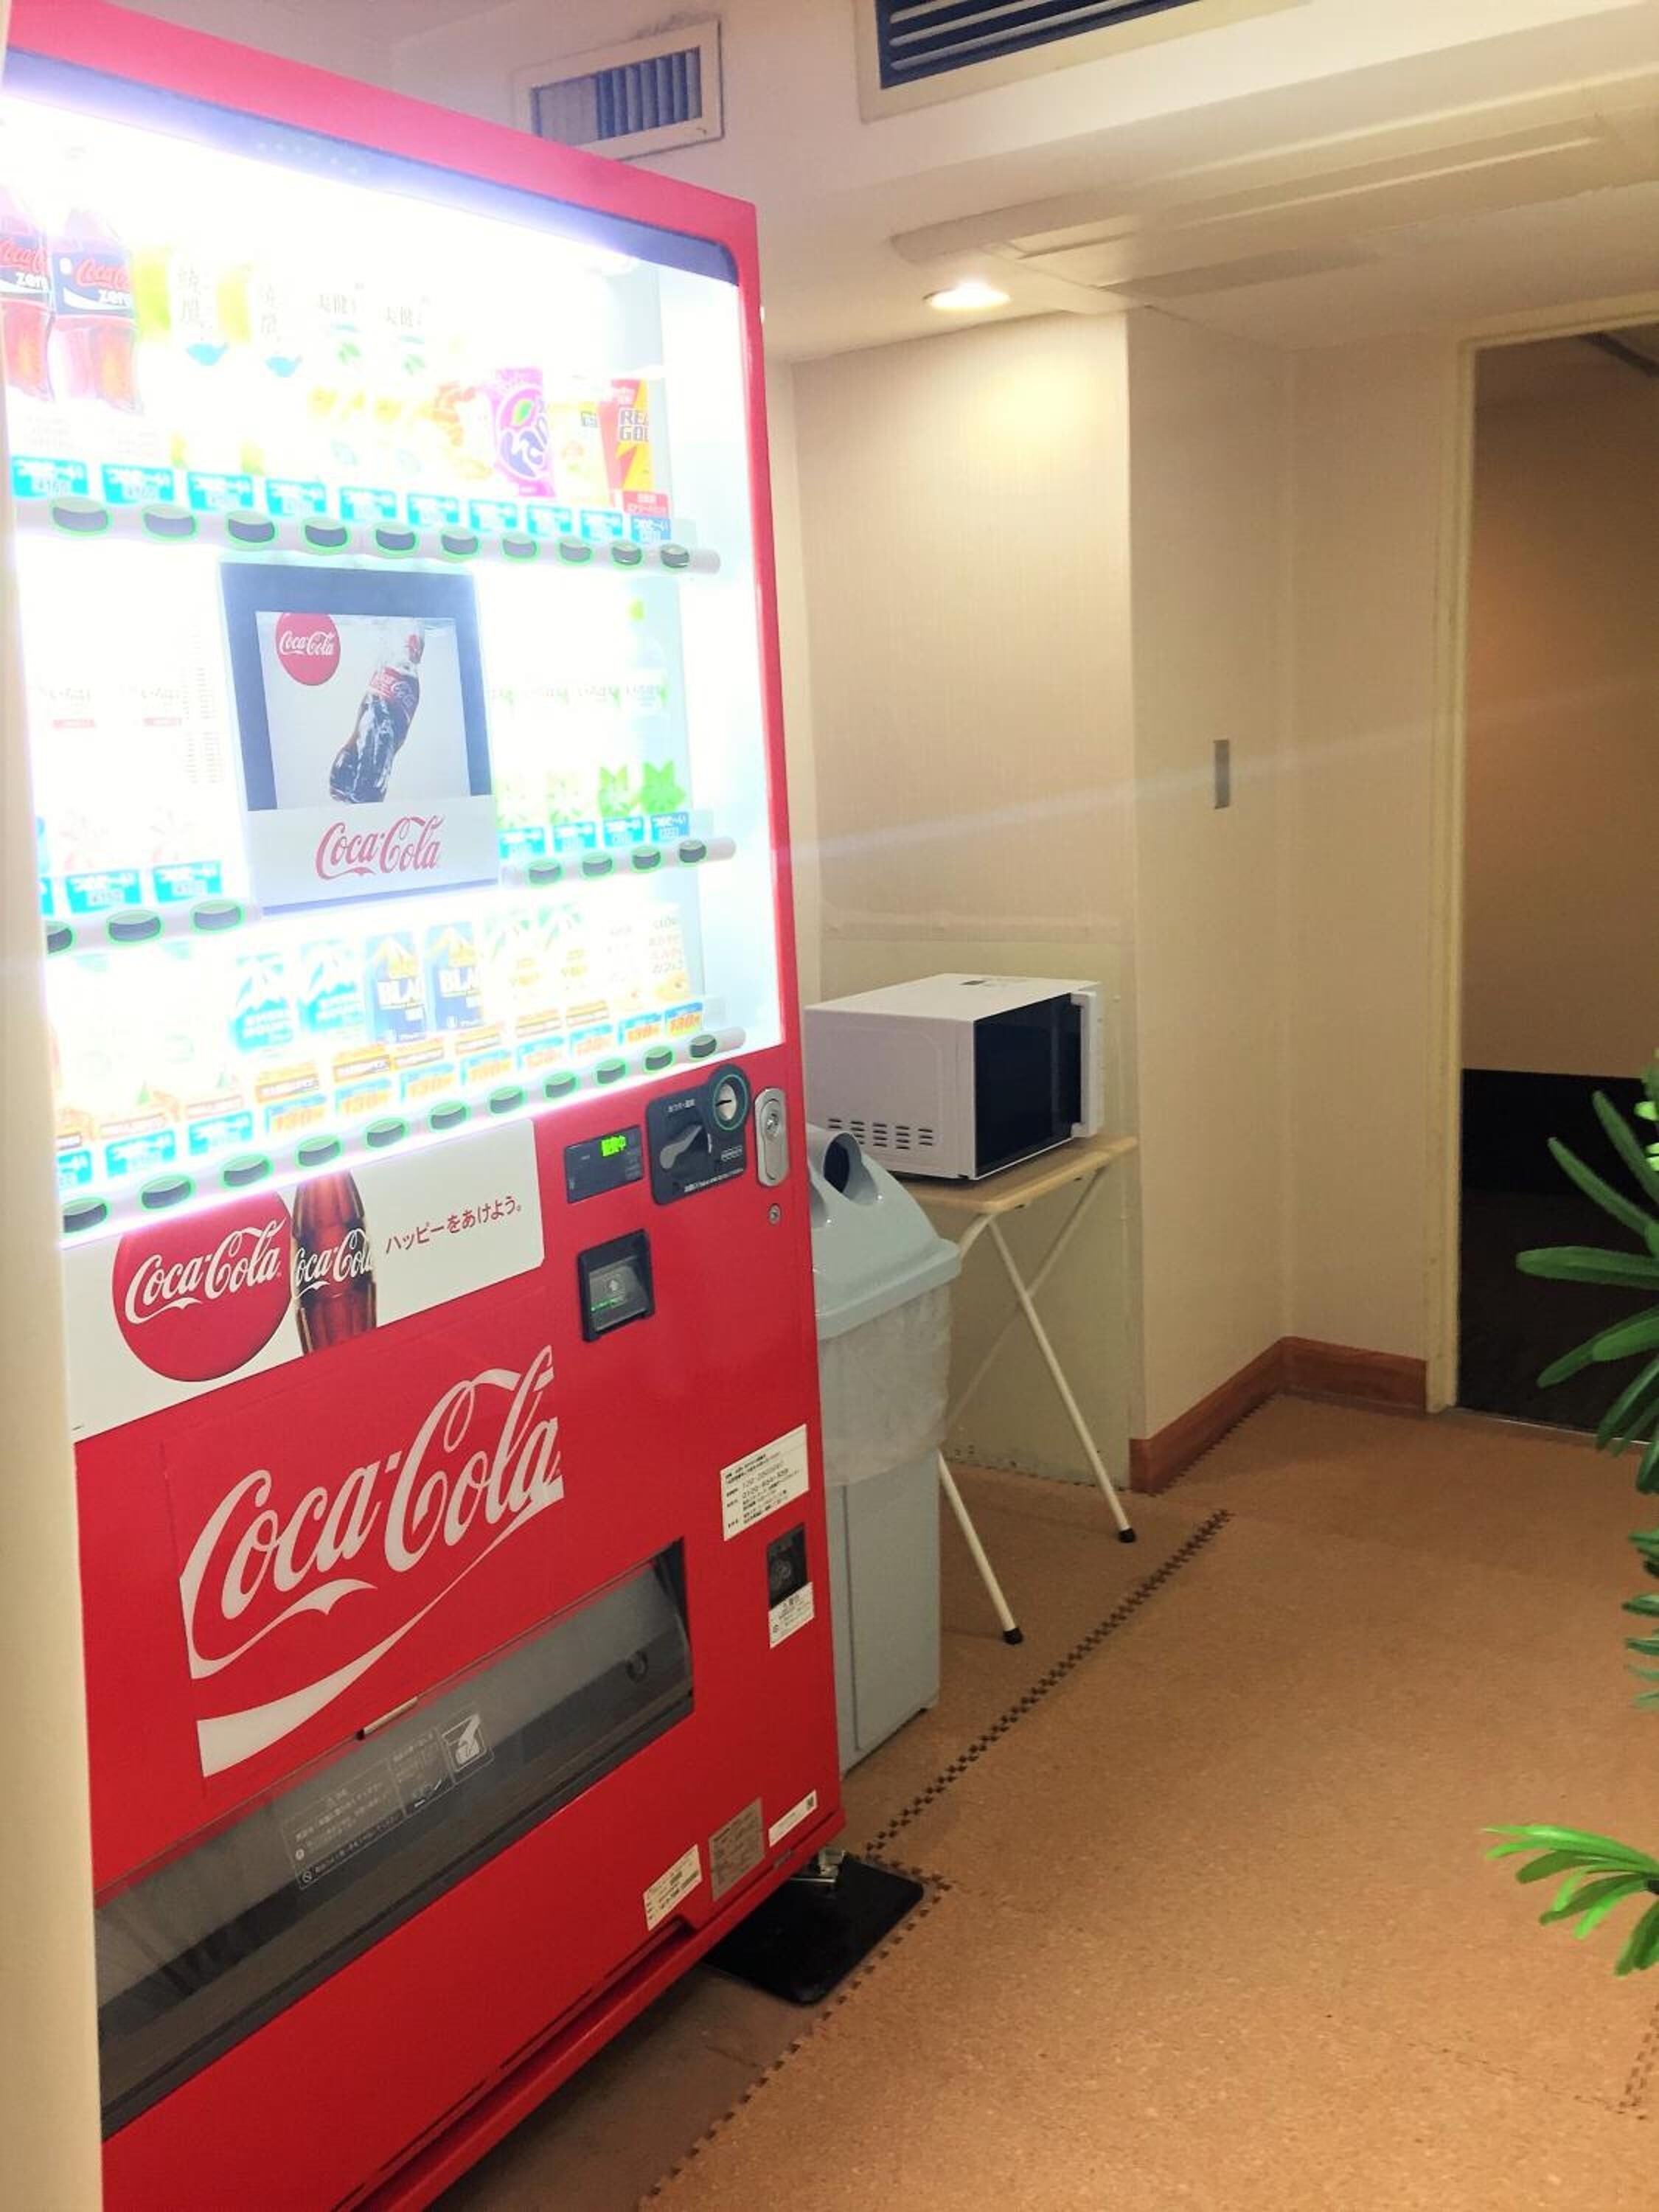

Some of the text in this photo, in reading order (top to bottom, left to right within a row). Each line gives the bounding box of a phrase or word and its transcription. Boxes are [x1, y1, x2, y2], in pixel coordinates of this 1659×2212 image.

[279, 630, 337, 657] Coca-Cola
[316, 814, 445, 880] Coca-Cola
[385, 1194, 521, 1253] ハッピーをあけよう。
[125, 1217, 286, 1325] Coca-Cola
[179, 1345, 566, 1680] Coca-Cola
